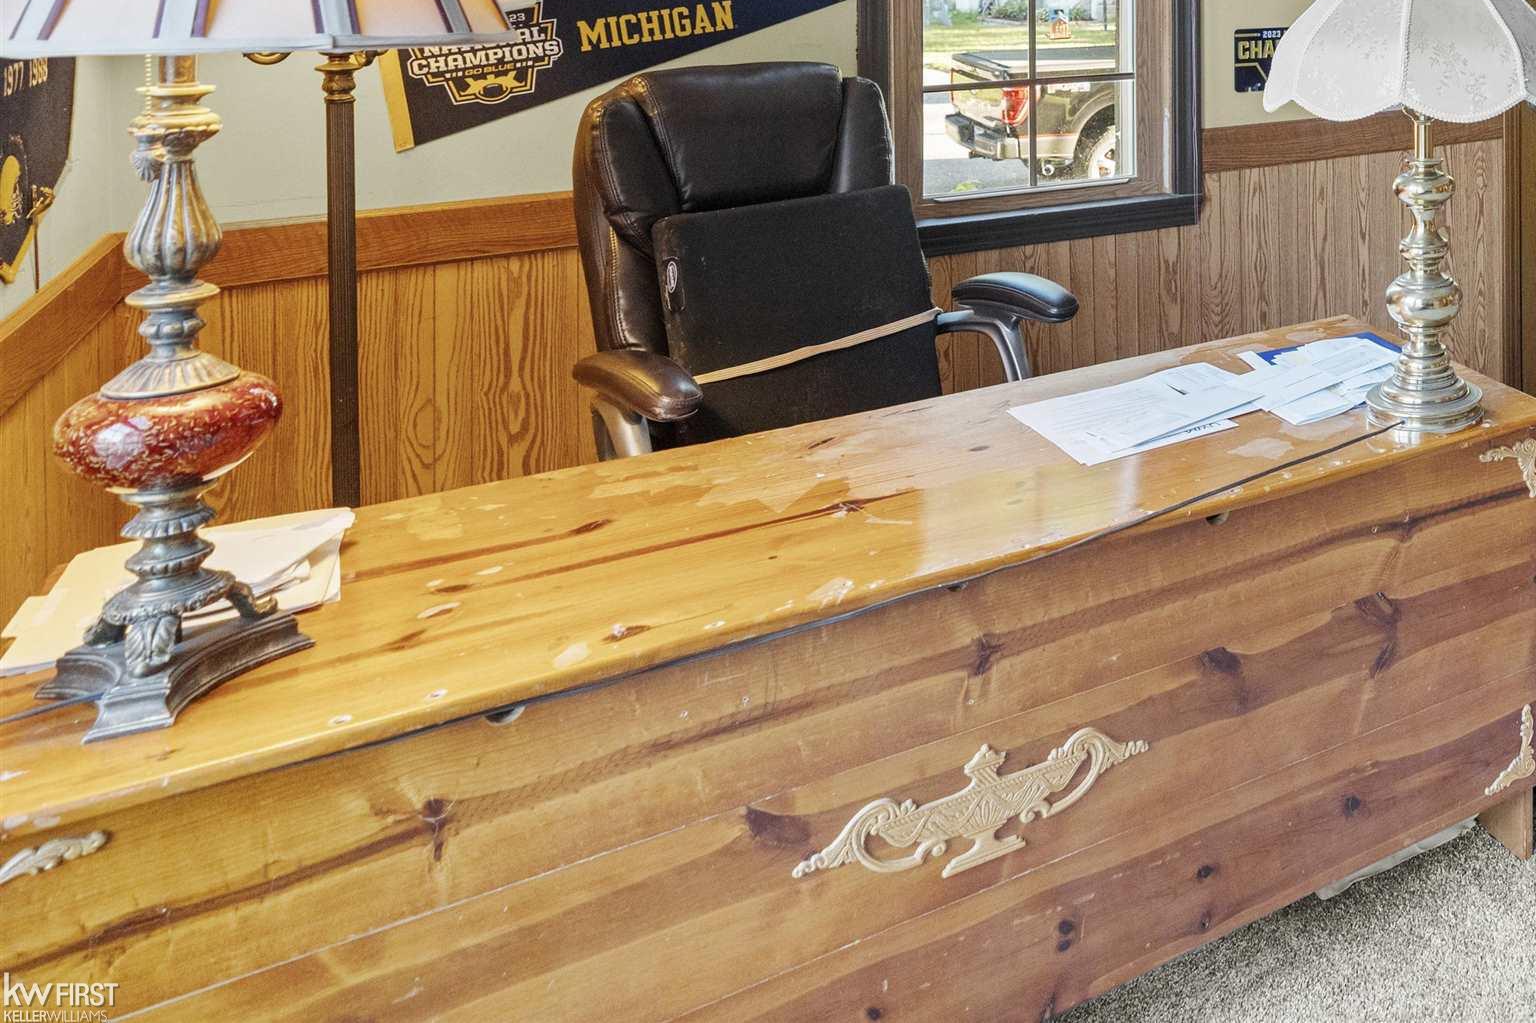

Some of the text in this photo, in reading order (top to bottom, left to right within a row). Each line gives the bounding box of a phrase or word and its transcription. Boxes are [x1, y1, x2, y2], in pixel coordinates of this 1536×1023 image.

[576, 0, 735, 53] MICHIGAN
[412, 40, 561, 75] CHAMPIONS
[1238, 40, 1280, 59] CHA
[464, 63, 515, 76] GO BLUE
